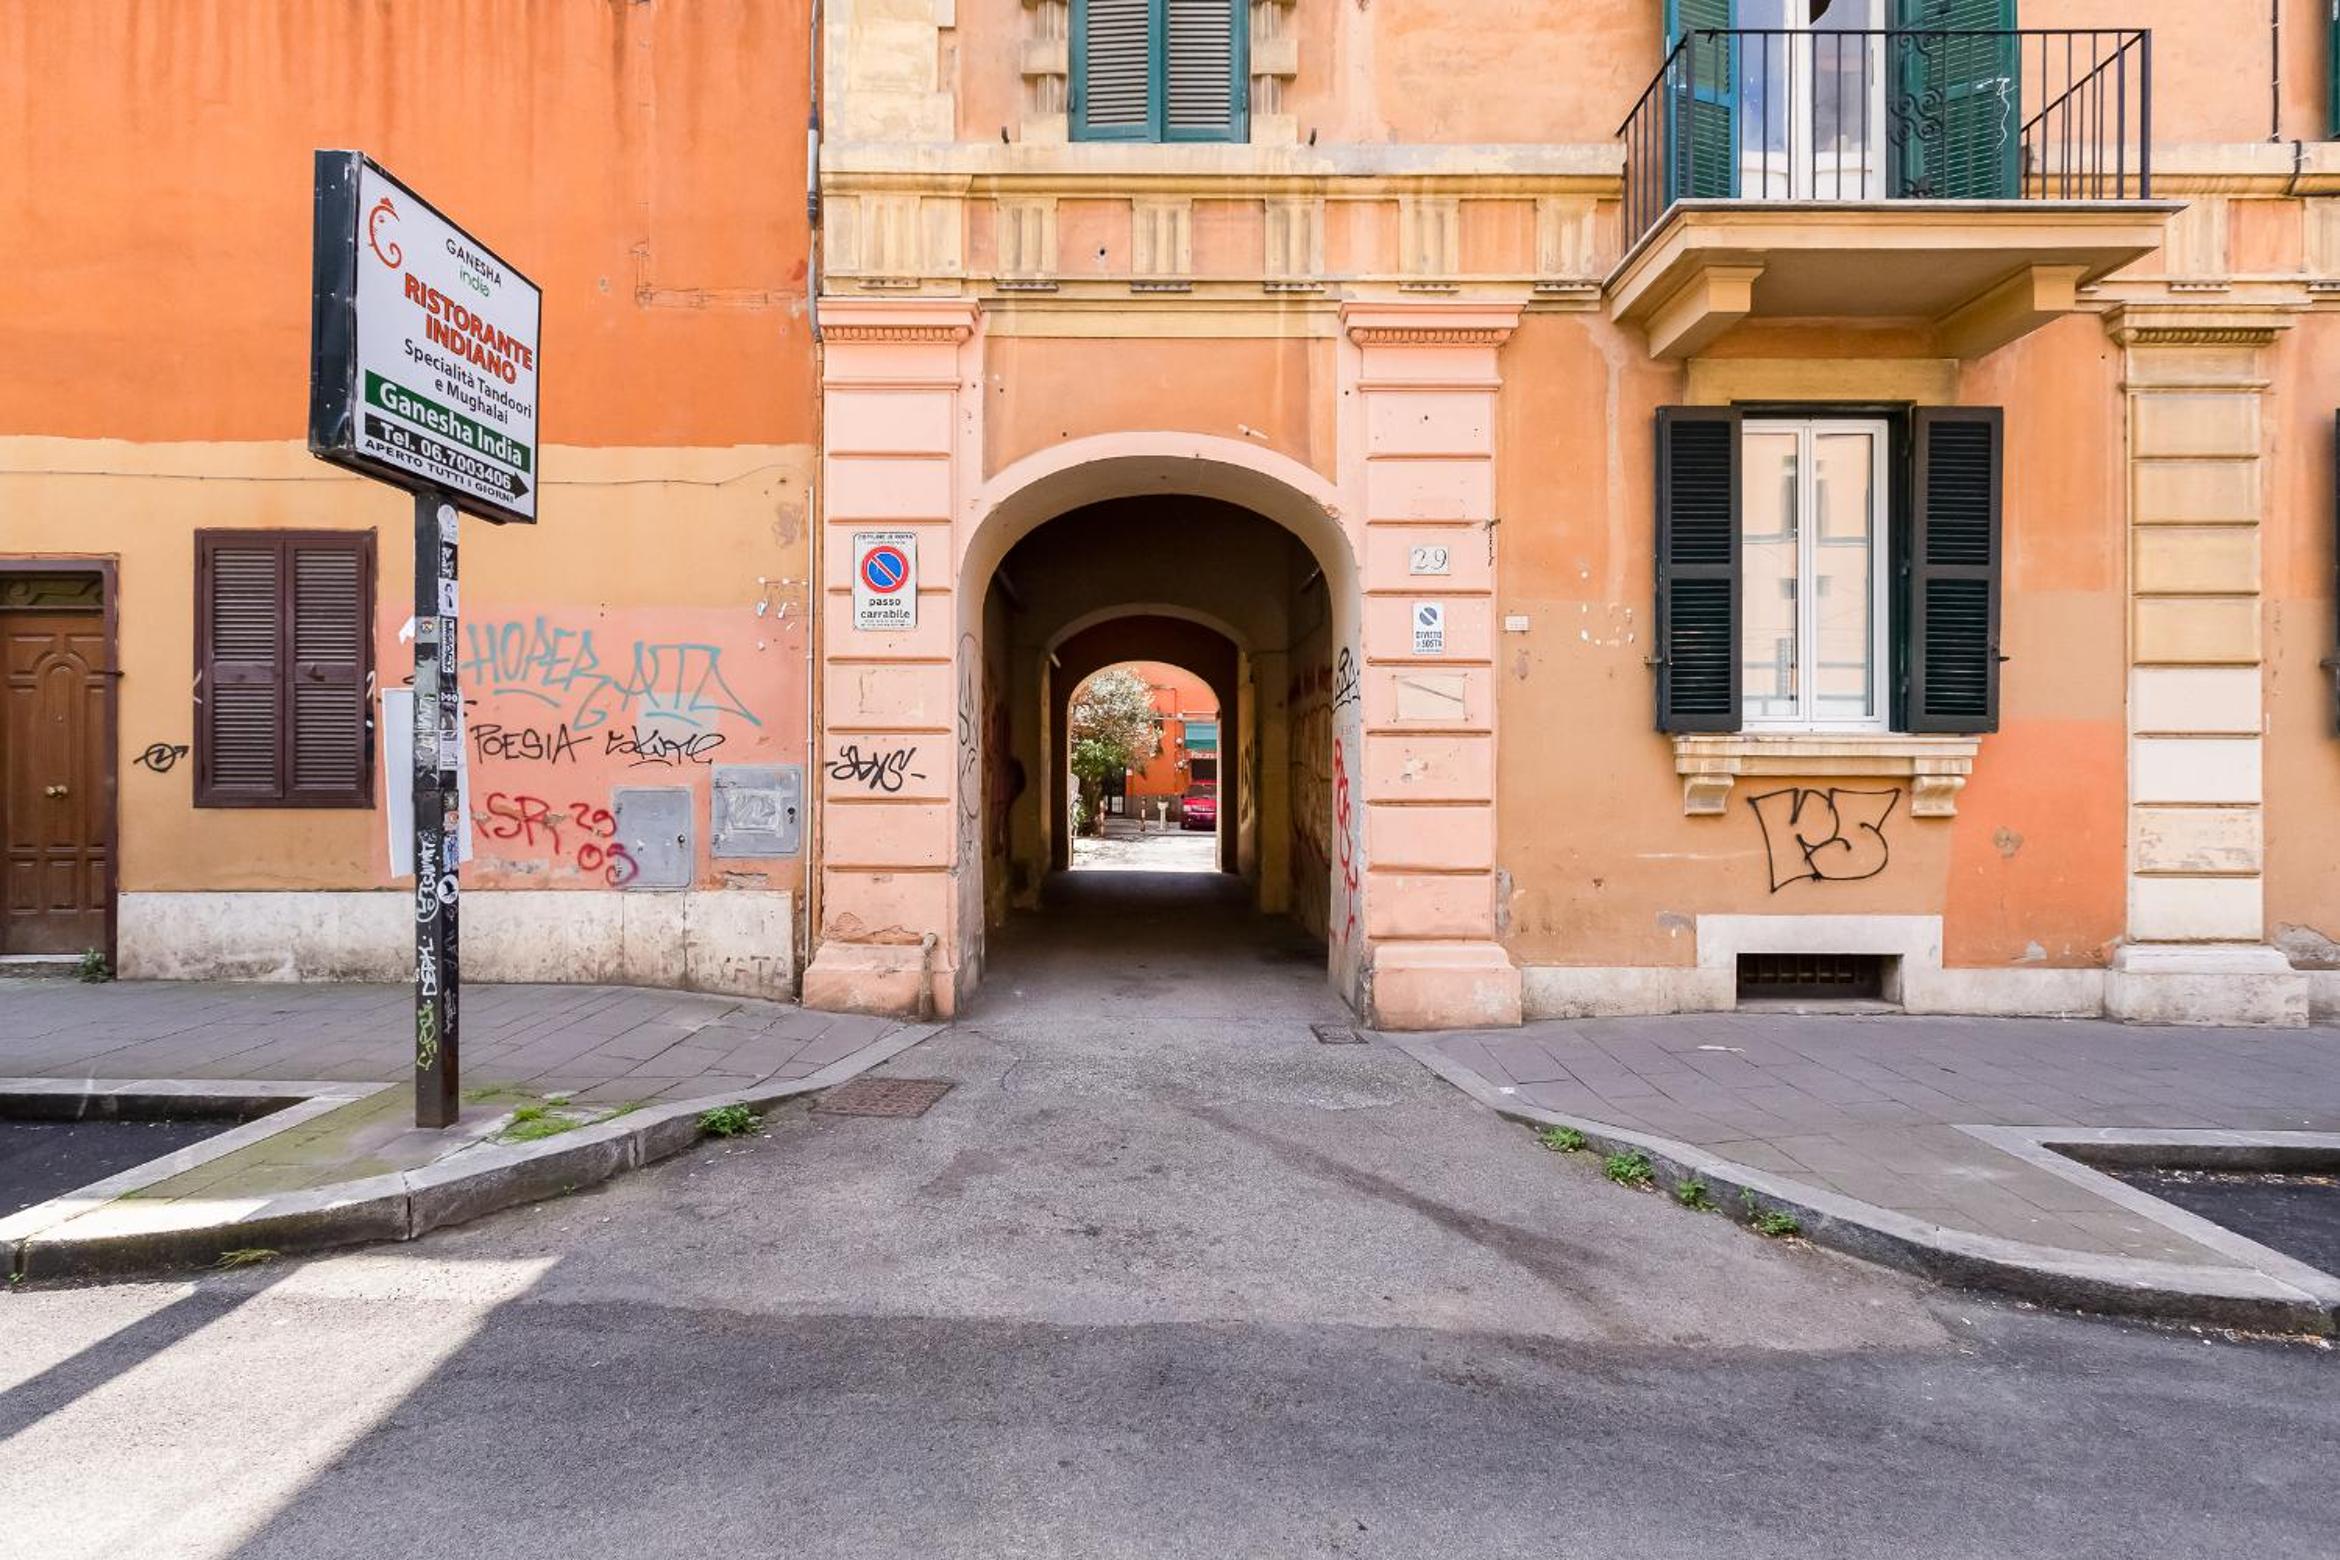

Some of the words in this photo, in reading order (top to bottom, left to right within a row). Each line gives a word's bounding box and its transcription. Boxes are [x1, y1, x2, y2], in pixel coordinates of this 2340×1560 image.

[446, 238, 502, 287] GANESHA
[460, 266, 490, 297] india
[405, 272, 533, 371] RISTORANTE
[426, 314, 517, 385] INDIANO
[405, 338, 475, 389] Specialità
[478, 376, 531, 418] Tandoori
[435, 379, 444, 392] e
[447, 381, 508, 424] Mughalai
[380, 382, 473, 444] Ganesha
[478, 424, 522, 467] India
[365, 439, 423, 468] APERTO
[427, 464, 464, 485] TUTTI
[475, 481, 514, 503] GIORNI
[380, 422, 415, 451] Tel.
[421, 440, 512, 490] 06.7003406
[1414, 549, 1447, 570] 29
[860, 609, 910, 619] carrabile
[869, 598, 901, 607] passo
[470, 723, 593, 764] POESIA
